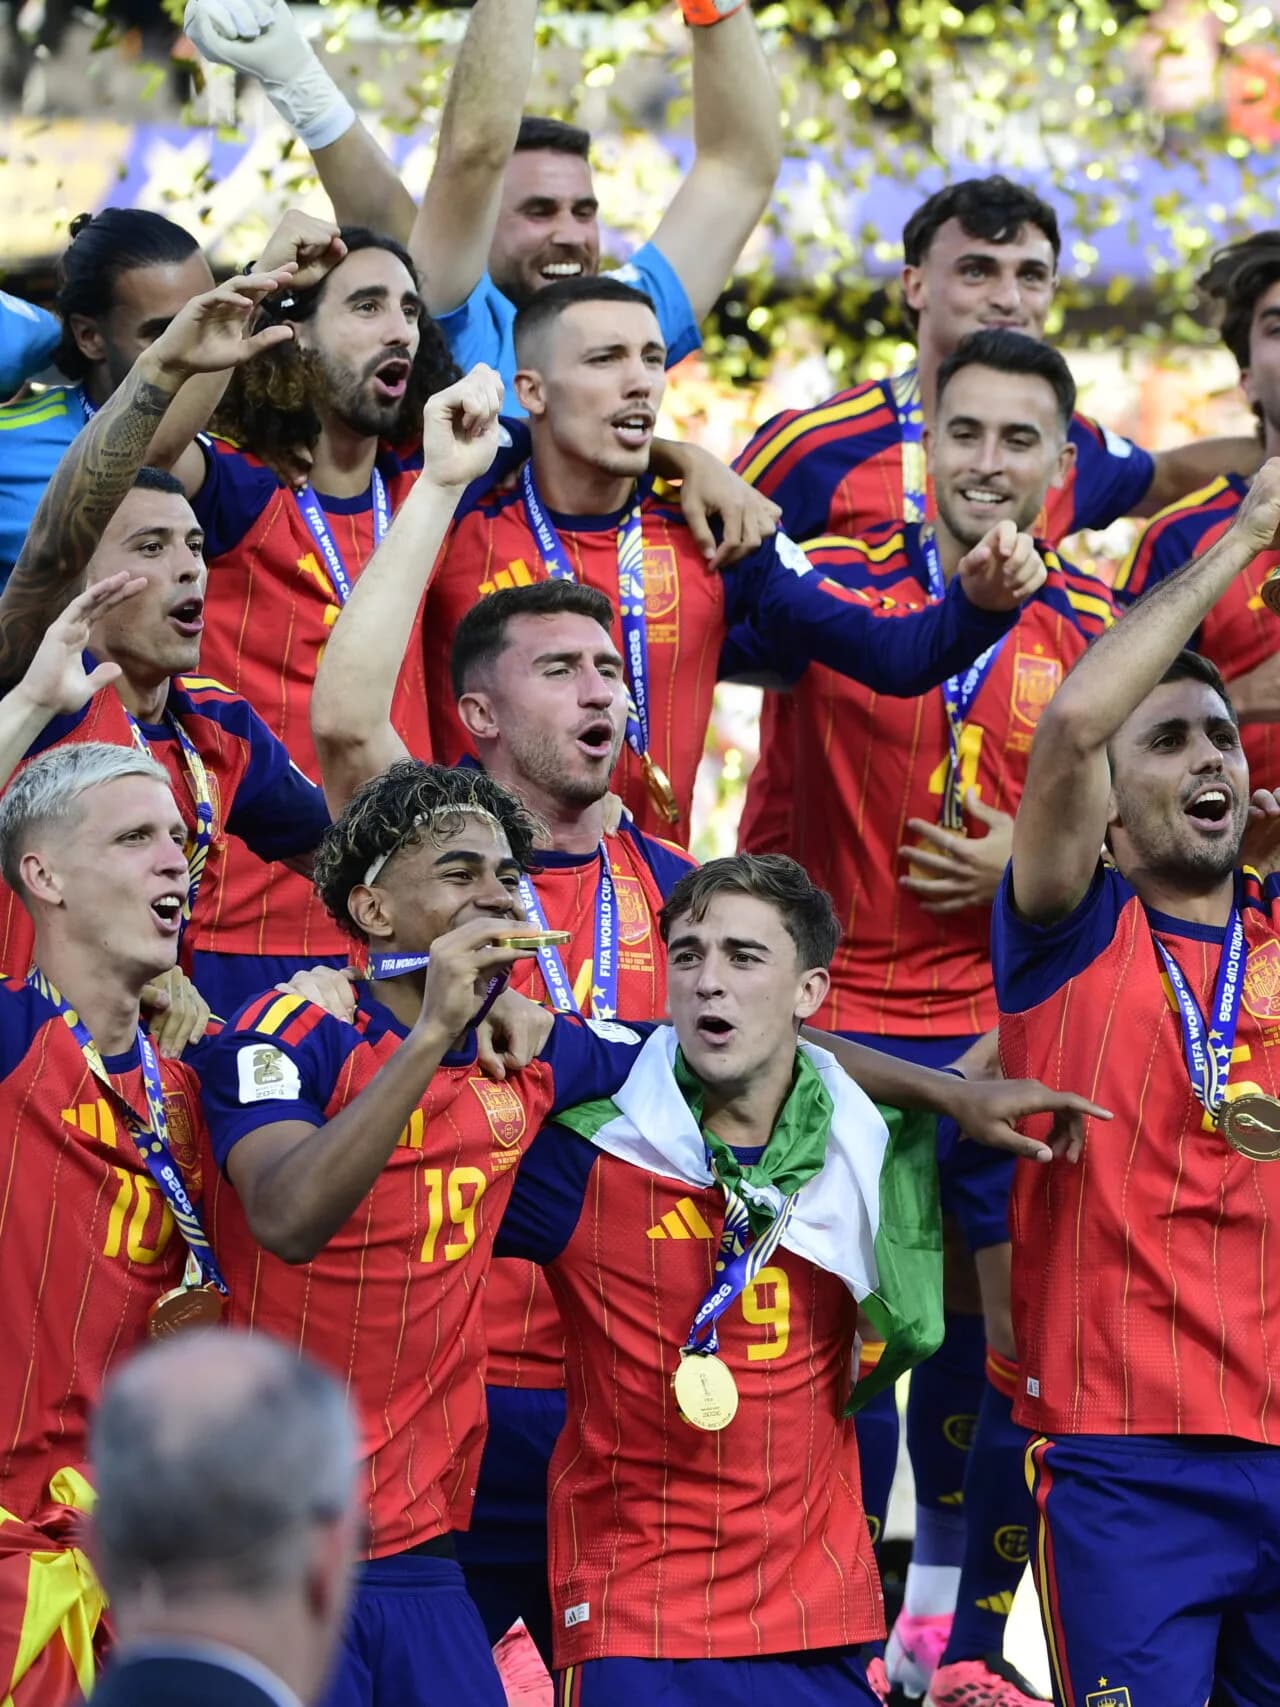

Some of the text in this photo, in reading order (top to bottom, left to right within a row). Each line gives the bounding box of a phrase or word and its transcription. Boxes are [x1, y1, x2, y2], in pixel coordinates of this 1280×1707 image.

[524, 484, 544, 526] WORLD
[305, 506, 353, 601] FIFA WORLD CU
[537, 523, 555, 552] FIFA
[629, 629, 643, 678] 2026
[634, 678, 645, 707] CUP
[519, 879, 535, 909] FIFA
[599, 877, 613, 977] FIFA WORLD CUP
[1229, 921, 1244, 961] WORLD
[381, 958, 396, 971] FIFA
[545, 958, 572, 1010] CUP 20
[1226, 959, 1240, 984] CUP
[1169, 962, 1205, 1071] FIFA WORLD CUP
[1218, 982, 1236, 1023] 2026
[143, 1039, 156, 1070] FIFA
[159, 1164, 195, 1216] 2026
[103, 1167, 176, 1265] 10
[419, 1166, 488, 1264] 19
[694, 1283, 733, 1326] 2026
[741, 1266, 791, 1362] 9
